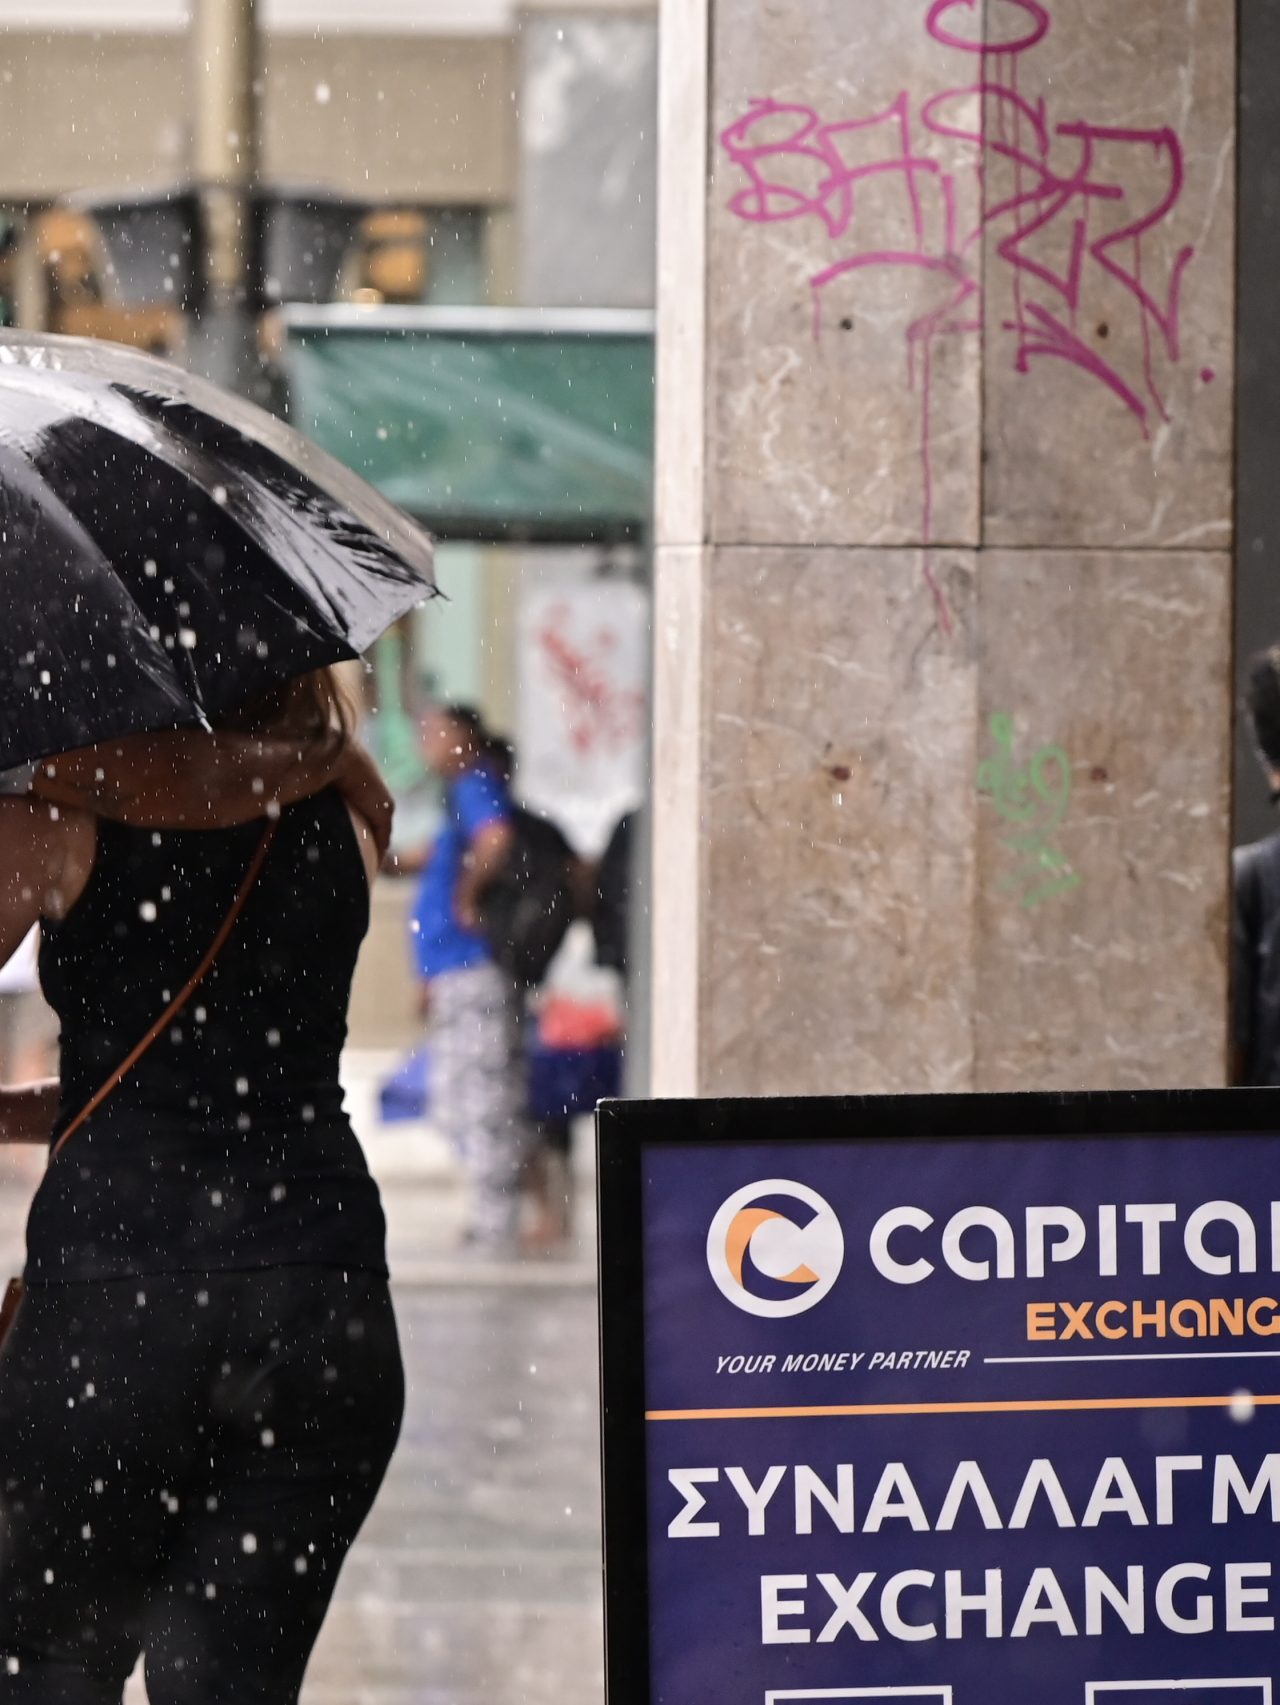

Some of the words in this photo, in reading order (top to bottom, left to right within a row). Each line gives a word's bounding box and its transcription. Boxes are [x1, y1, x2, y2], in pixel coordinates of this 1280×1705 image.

[870, 1201, 1280, 1284] CAPITA
[716, 1355, 776, 1374] YOUR
[781, 1352, 865, 1373] MONEY
[867, 1350, 971, 1370] PARTNER
[760, 1562, 1275, 1645] EXCHANGE
